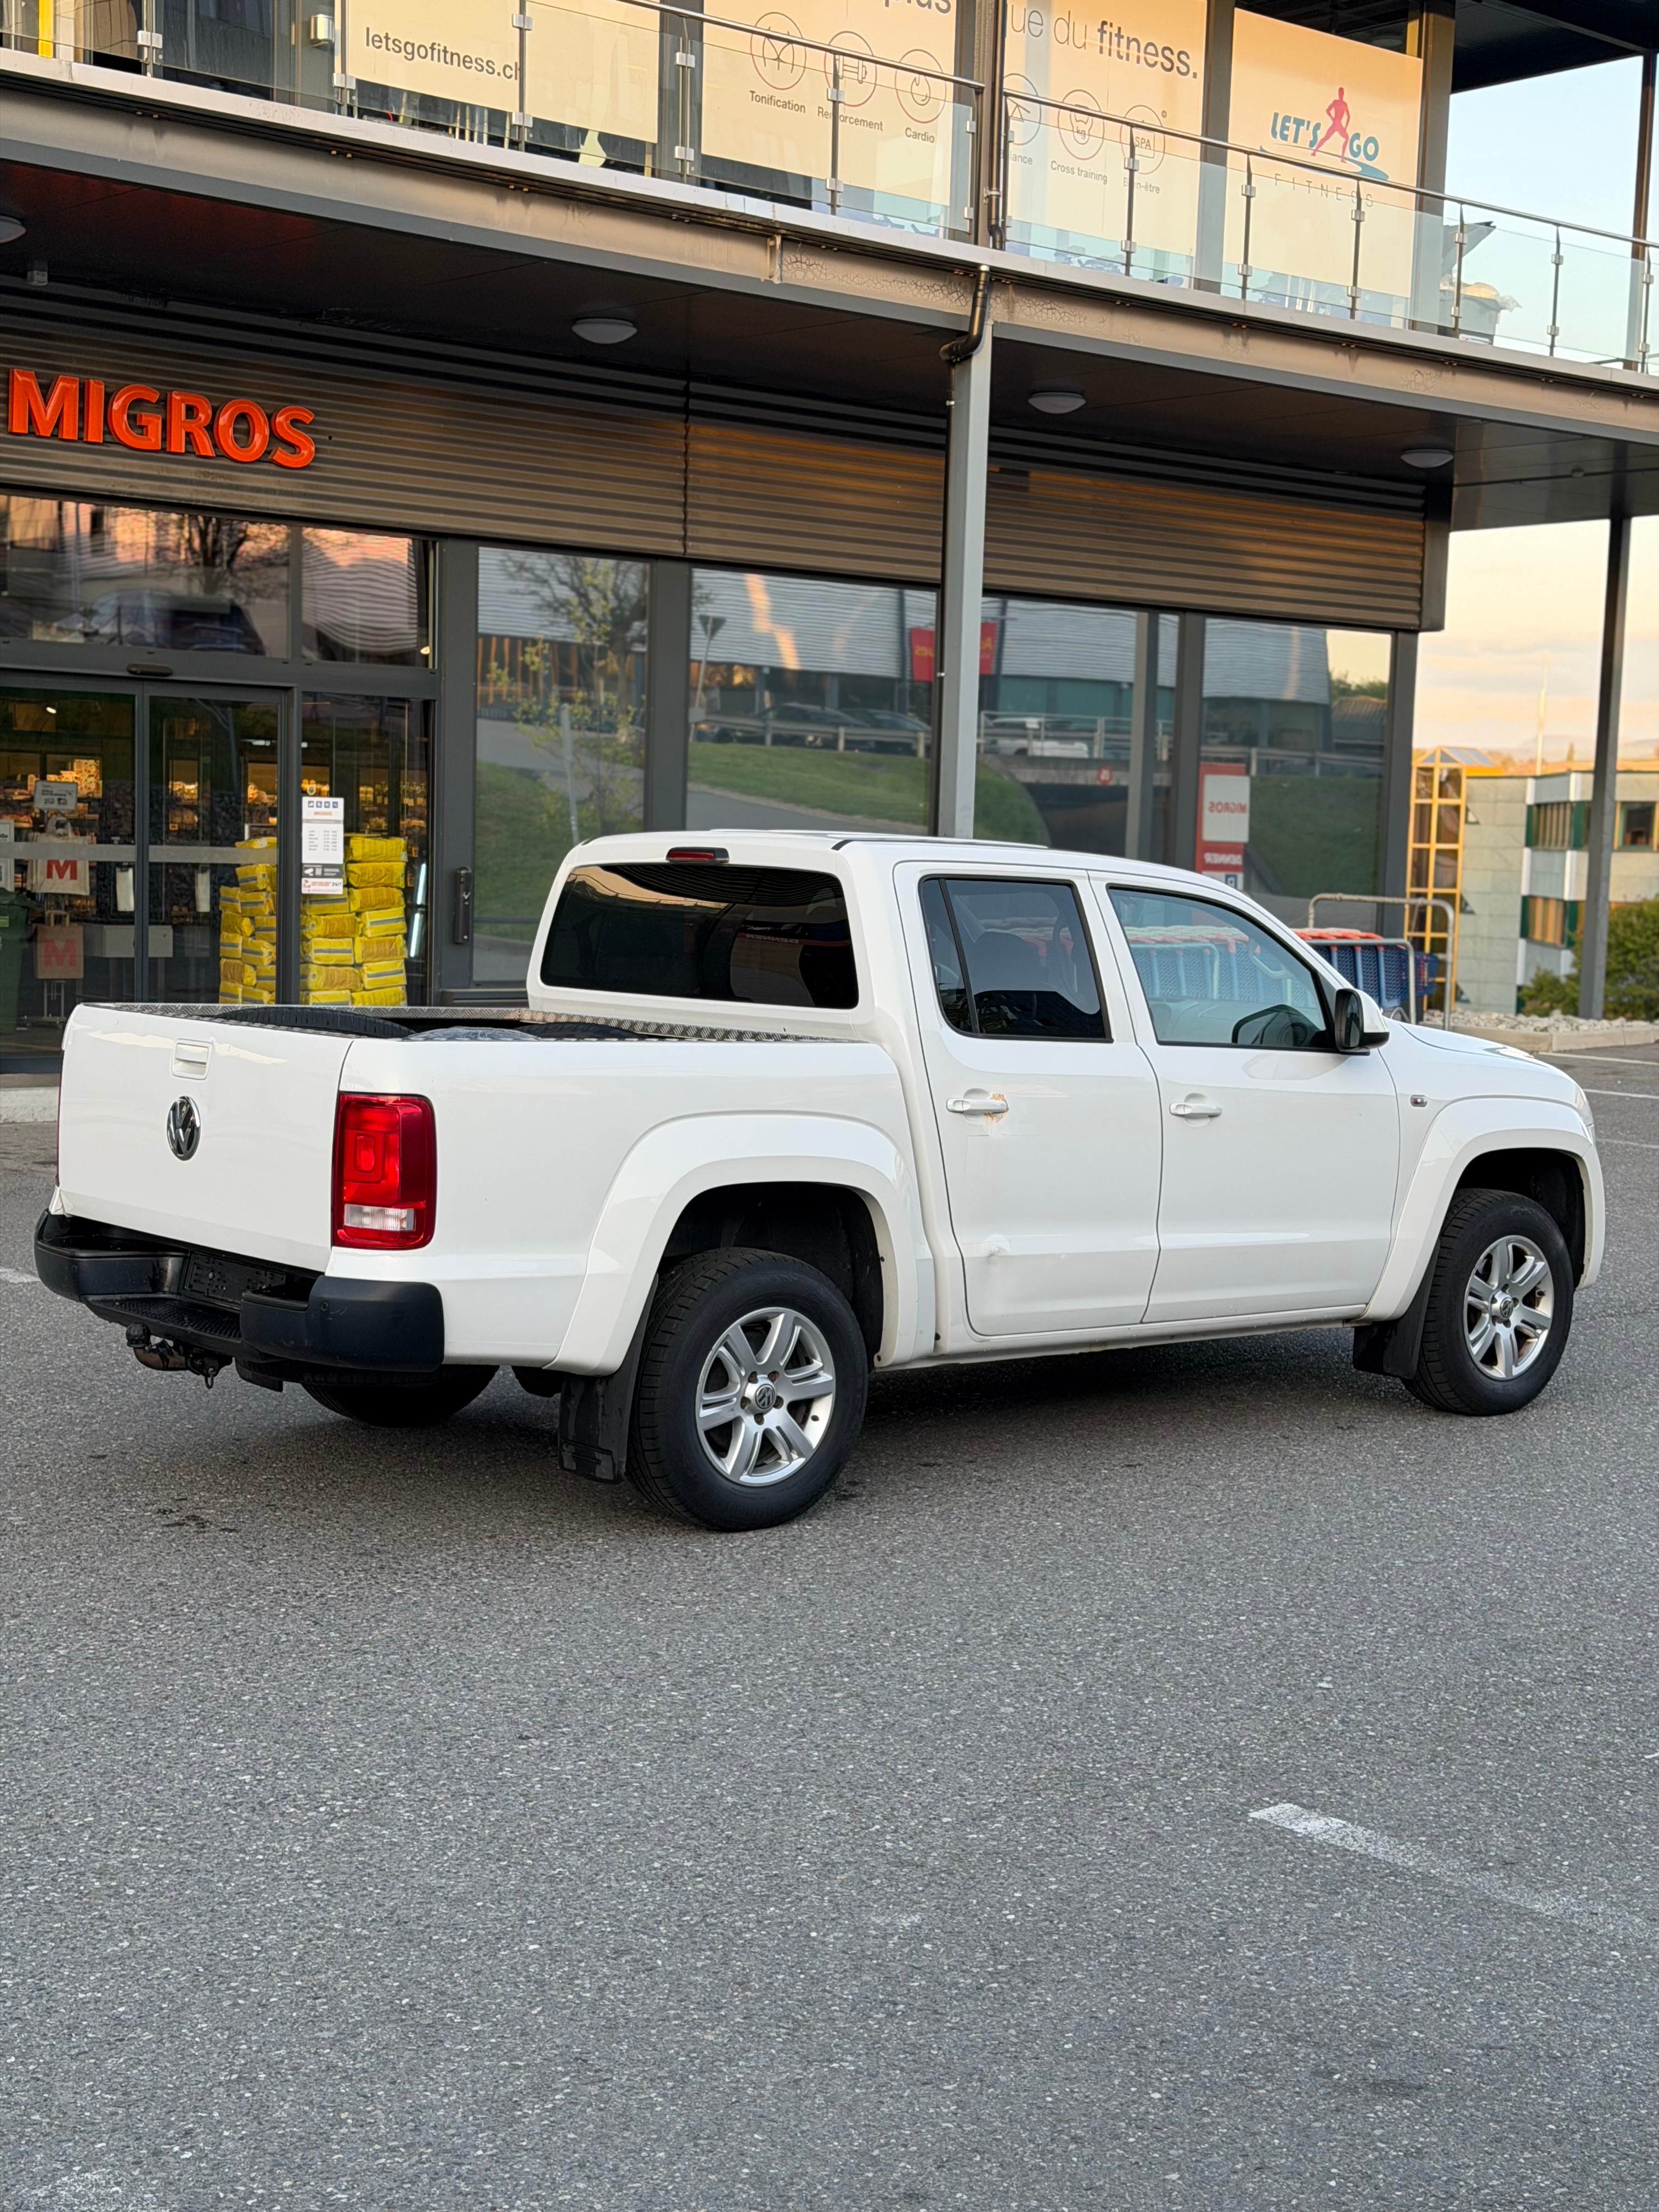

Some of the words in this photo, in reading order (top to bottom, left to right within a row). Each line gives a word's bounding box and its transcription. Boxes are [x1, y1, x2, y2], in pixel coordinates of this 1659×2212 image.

[1053, 10, 1088, 50] du
[1097, 20, 1199, 79] fitness.
[749, 90, 806, 114] Tonification
[905, 127, 935, 144] Cardio
[1135, 136, 1152, 150] SPA
[1271, 111, 1322, 148] LET'S
[1348, 132, 1380, 161] GO
[1050, 160, 1075, 175] Cross
[1077, 167, 1108, 185] training
[7, 368, 316, 469] MIGROS
[46, 859, 78, 881] M
[43, 939, 77, 967] M
